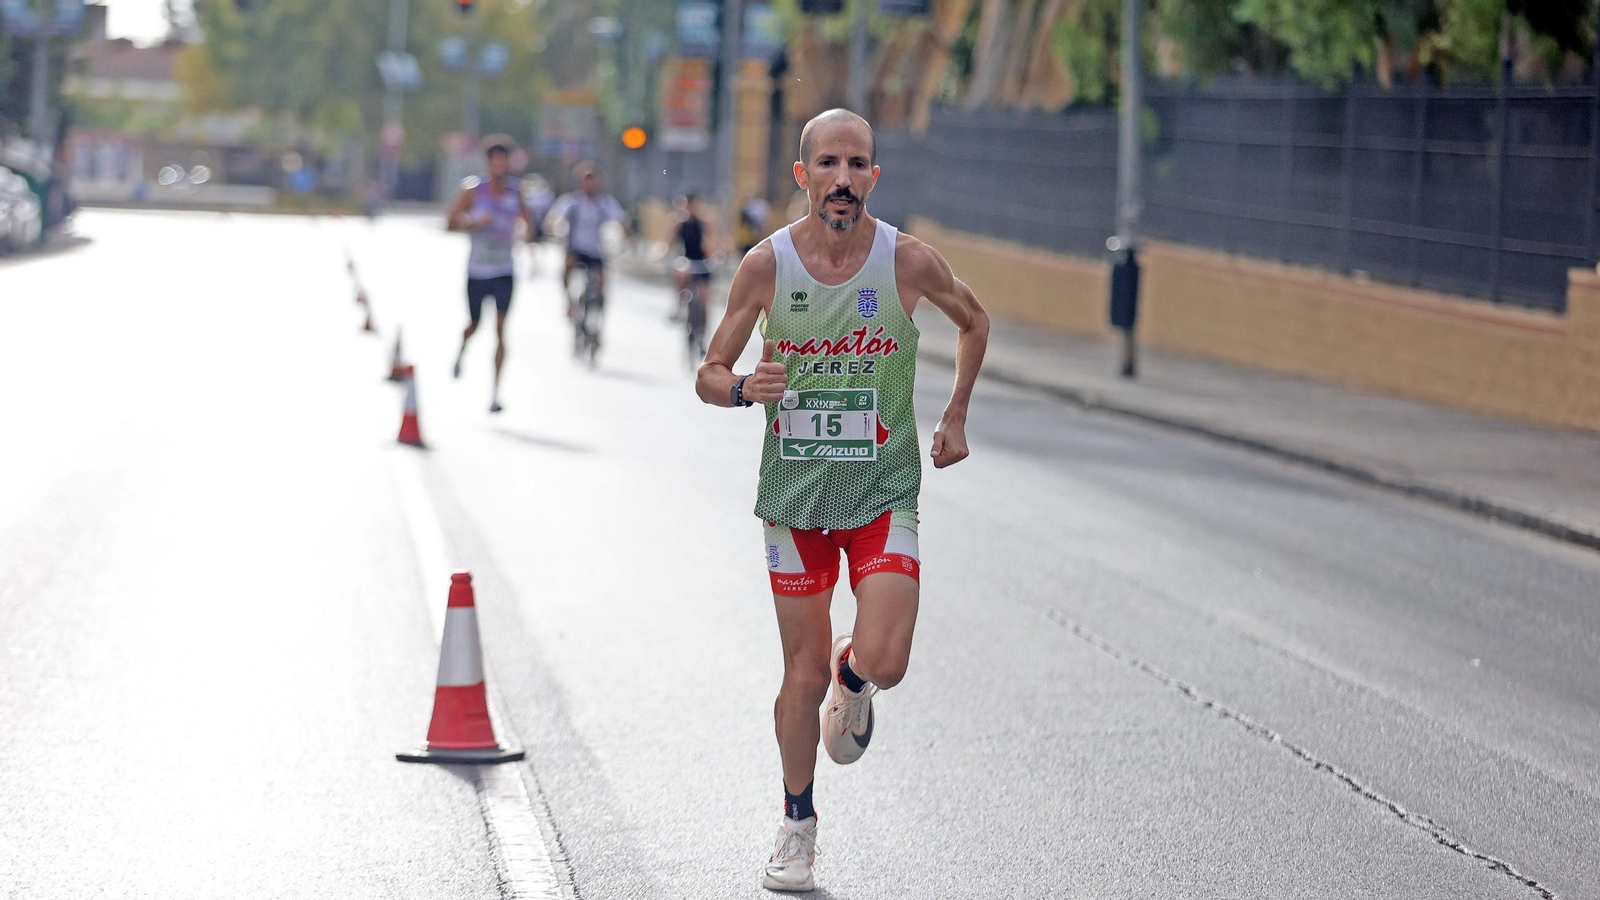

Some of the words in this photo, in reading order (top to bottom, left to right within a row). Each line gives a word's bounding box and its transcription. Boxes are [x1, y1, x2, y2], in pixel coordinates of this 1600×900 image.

[776, 325, 900, 358] maratón
[798, 360, 876, 376] JEREZ
[805, 399, 829, 409] XXIX
[811, 413, 842, 437] 15
[812, 444, 869, 456] MIZUNO
[857, 555, 891, 573] maratón
[861, 564, 881, 575] JEREZ
[777, 576, 816, 586] maratón
